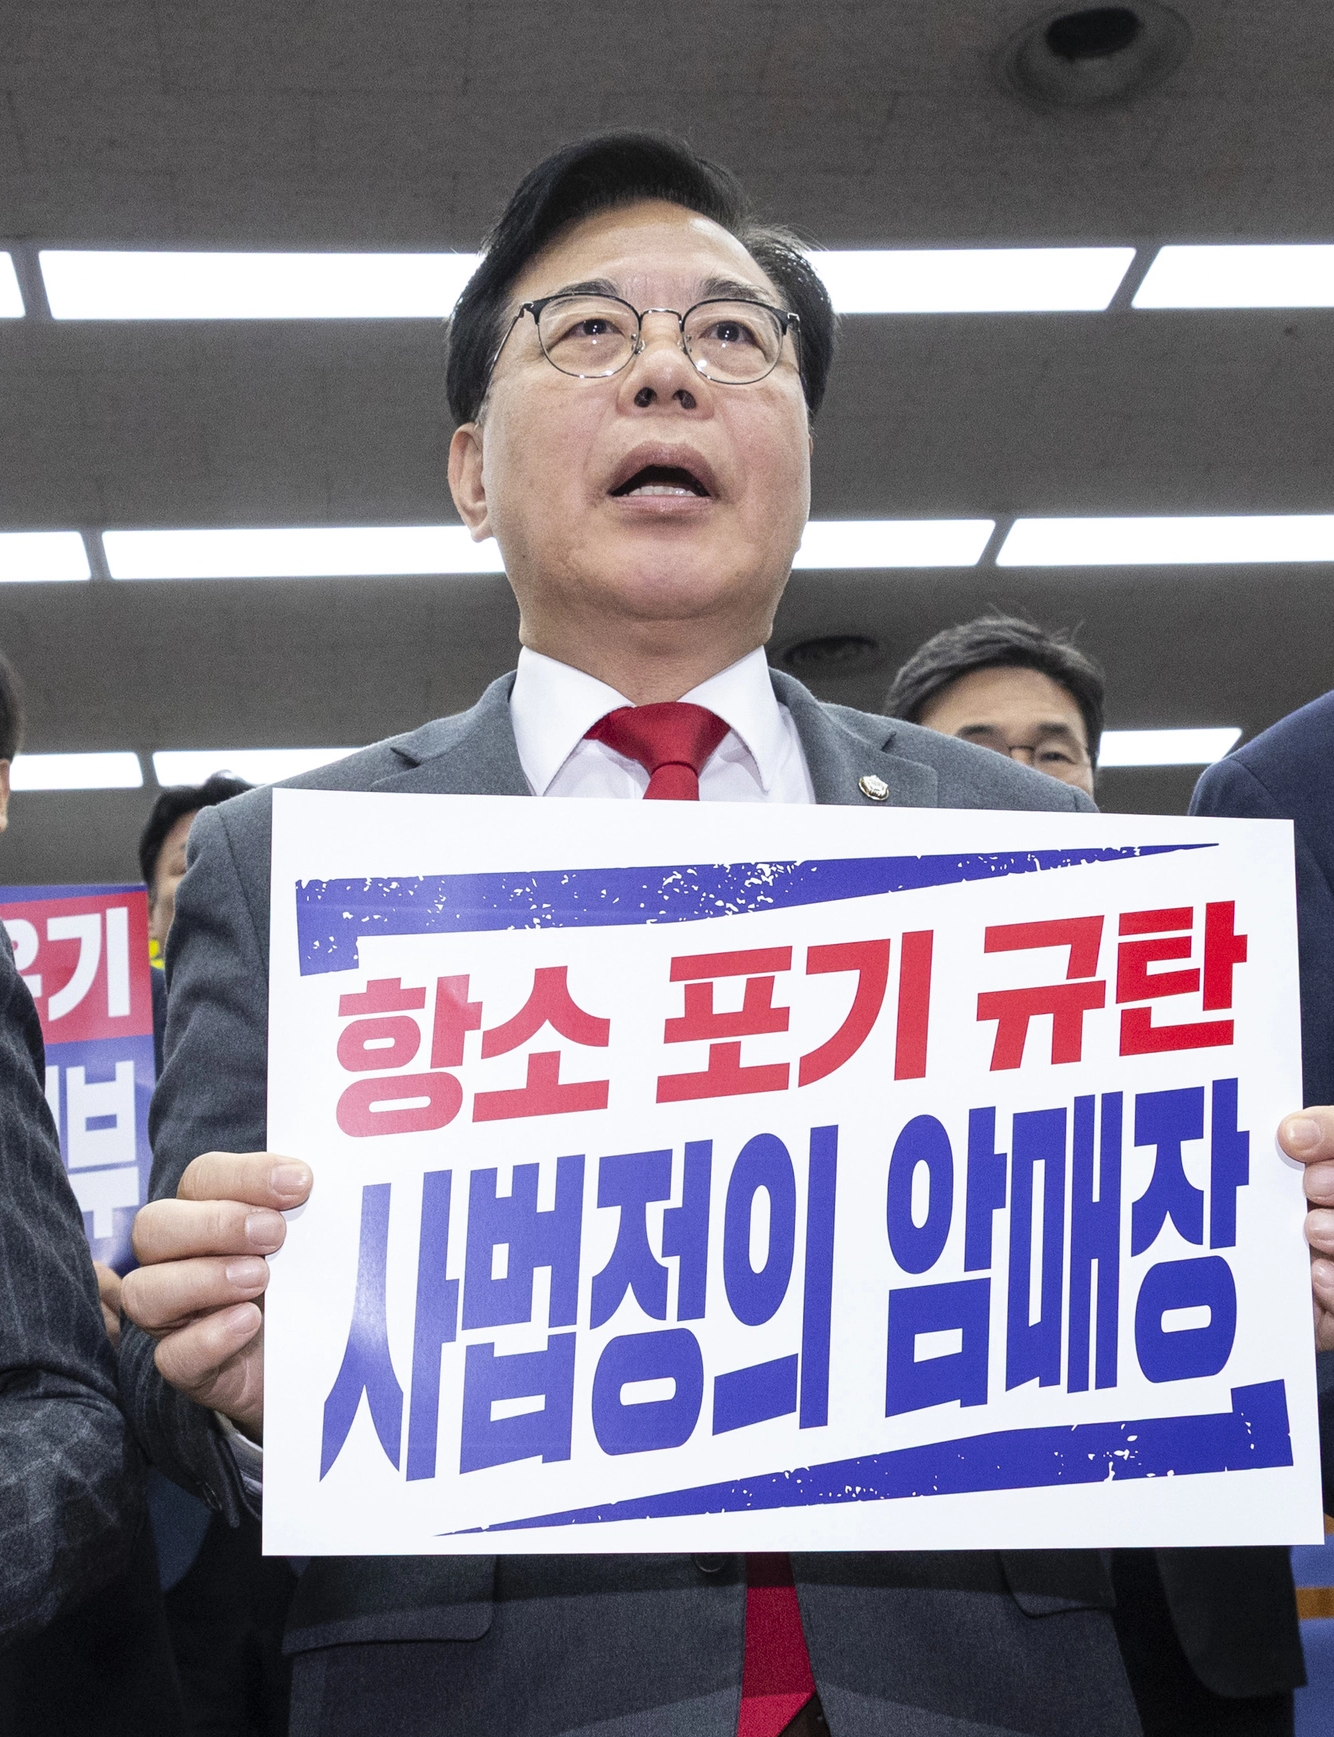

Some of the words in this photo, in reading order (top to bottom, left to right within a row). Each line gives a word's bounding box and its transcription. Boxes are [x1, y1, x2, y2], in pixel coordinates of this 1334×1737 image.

[335, 965, 611, 1138] 항소
[655, 929, 935, 1104] 포기
[975, 900, 1248, 1072] 규탄
[318, 1124, 839, 1482] 사법정의
[883, 1077, 1251, 1418] 암매장
